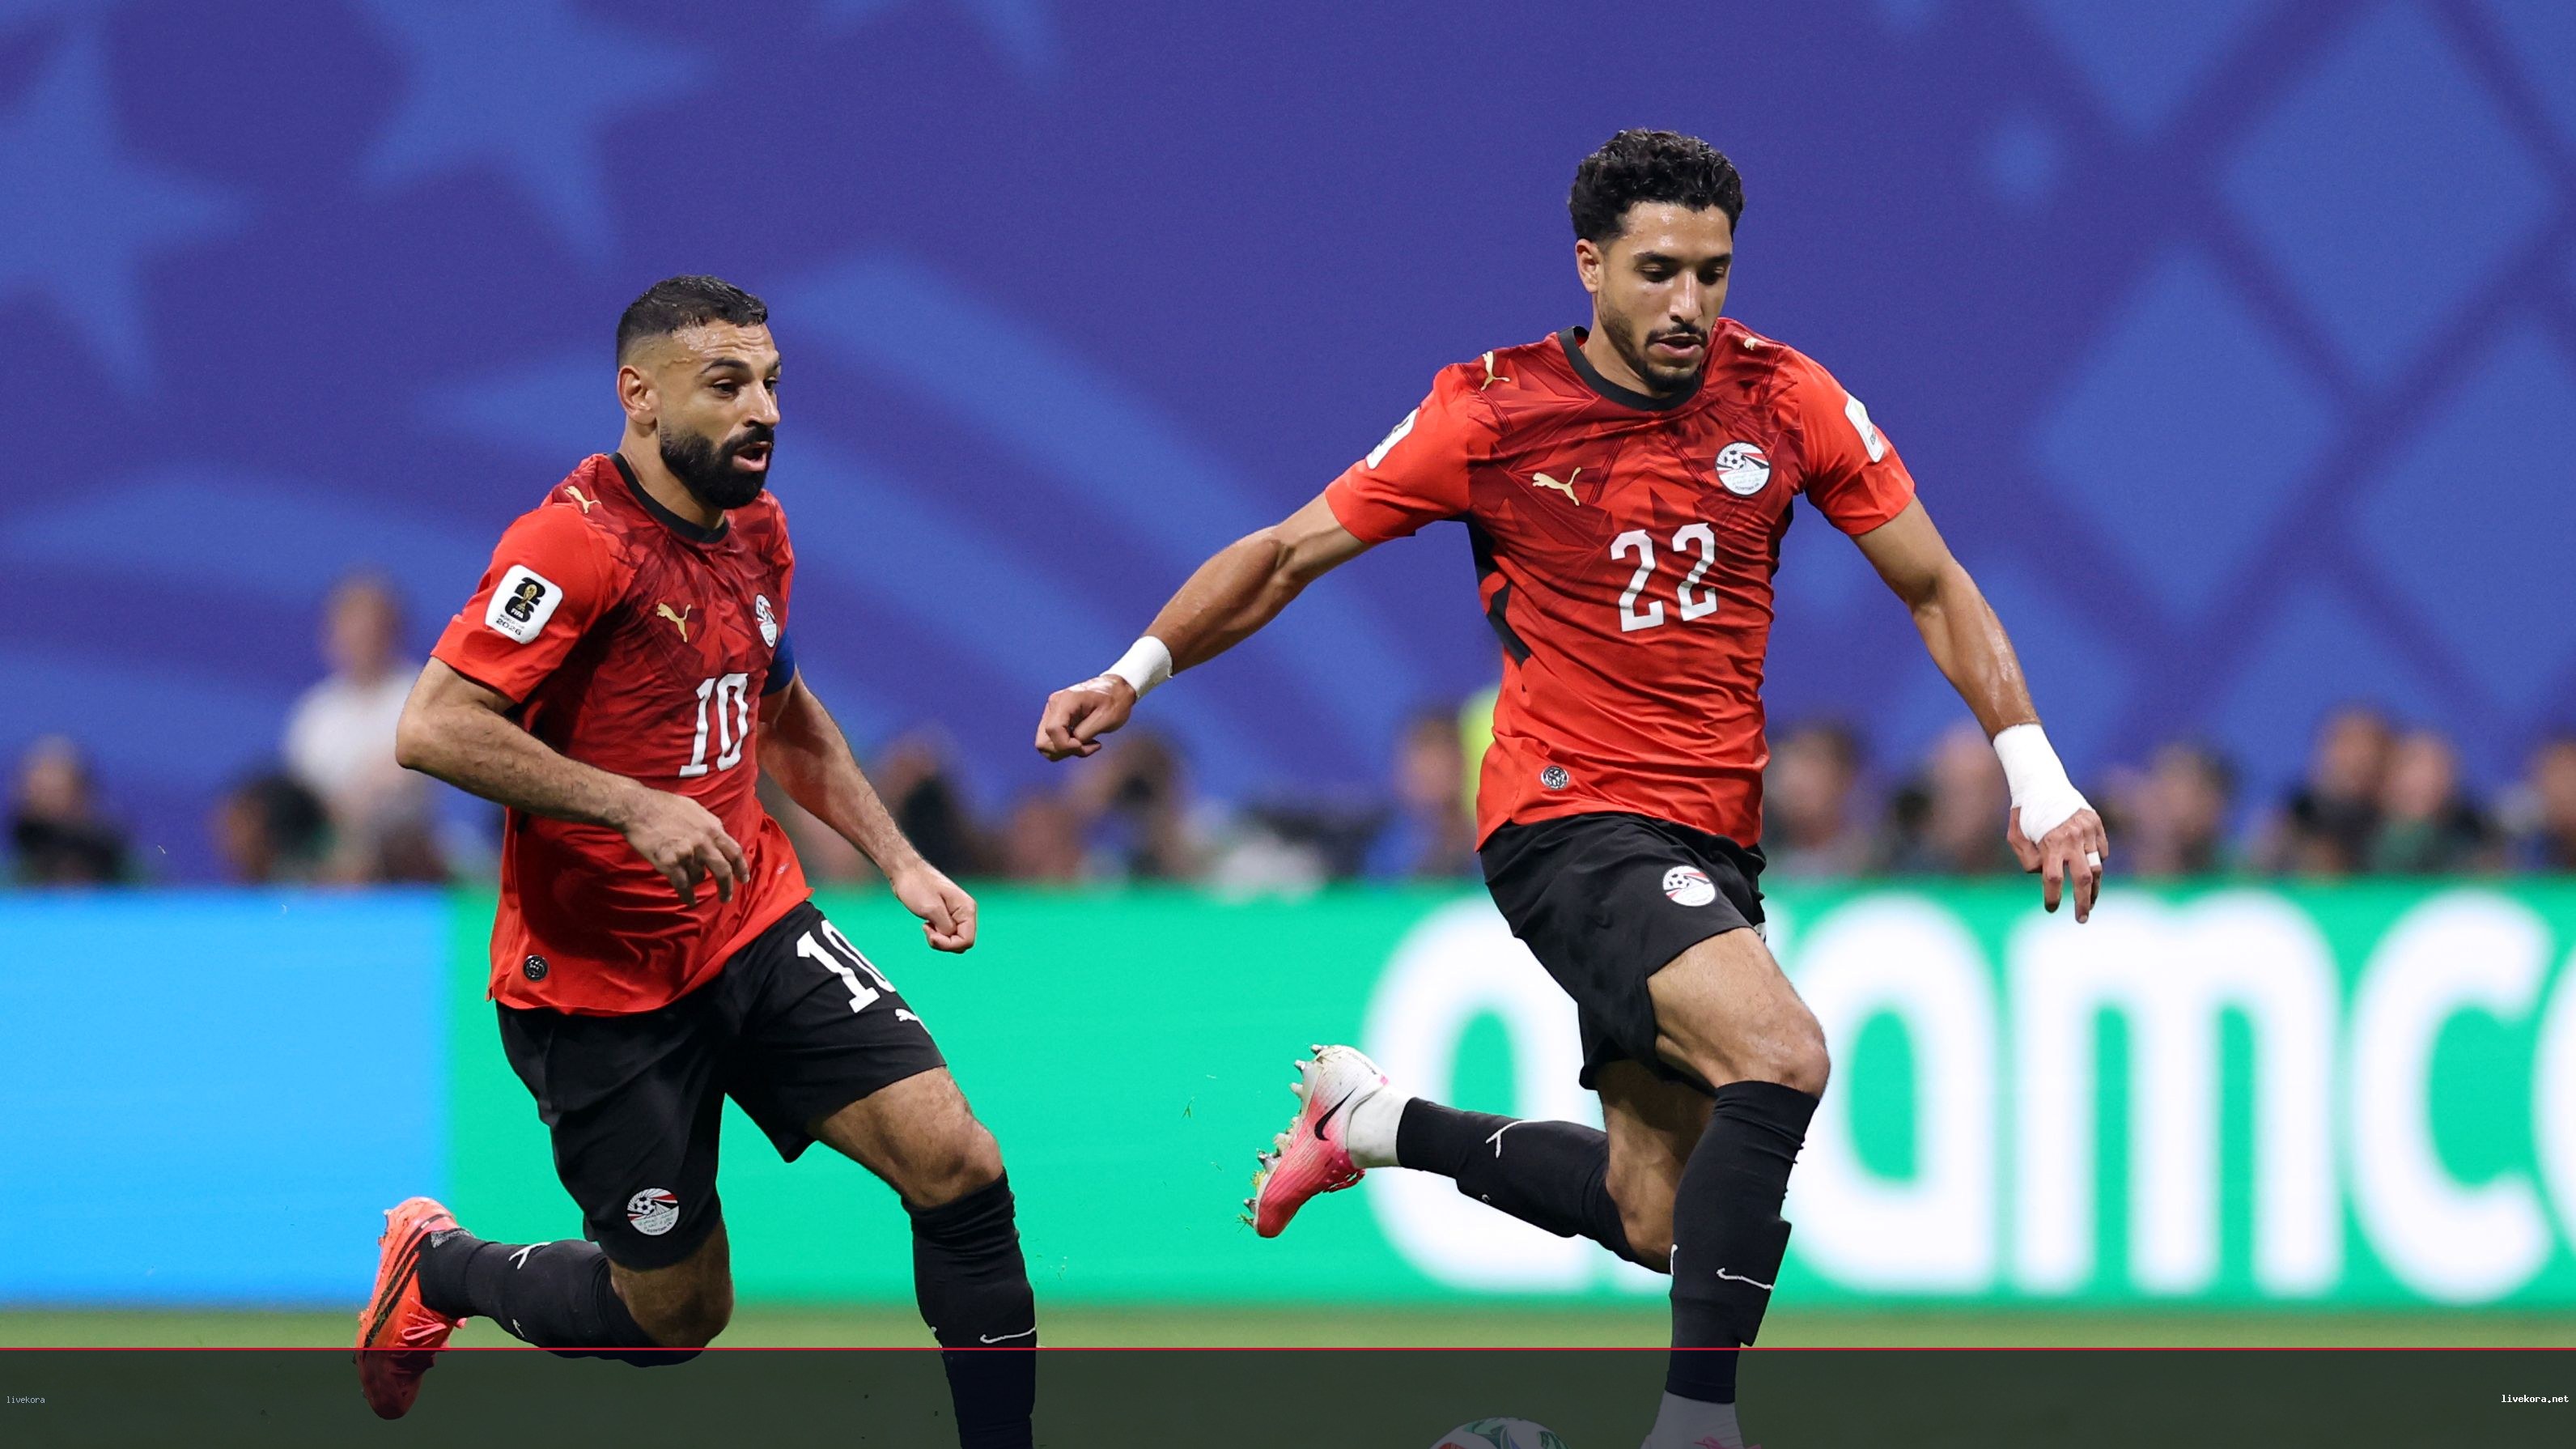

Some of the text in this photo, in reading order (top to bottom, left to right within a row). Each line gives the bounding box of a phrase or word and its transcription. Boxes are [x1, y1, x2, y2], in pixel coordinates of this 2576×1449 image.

[495, 618, 522, 635] 2026
[511, 607, 524, 618] FIFA
[1611, 523, 1717, 632] 22
[679, 673, 749, 776] 10
[796, 920, 897, 1013] 10
[1368, 892, 2576, 1298] aamc
